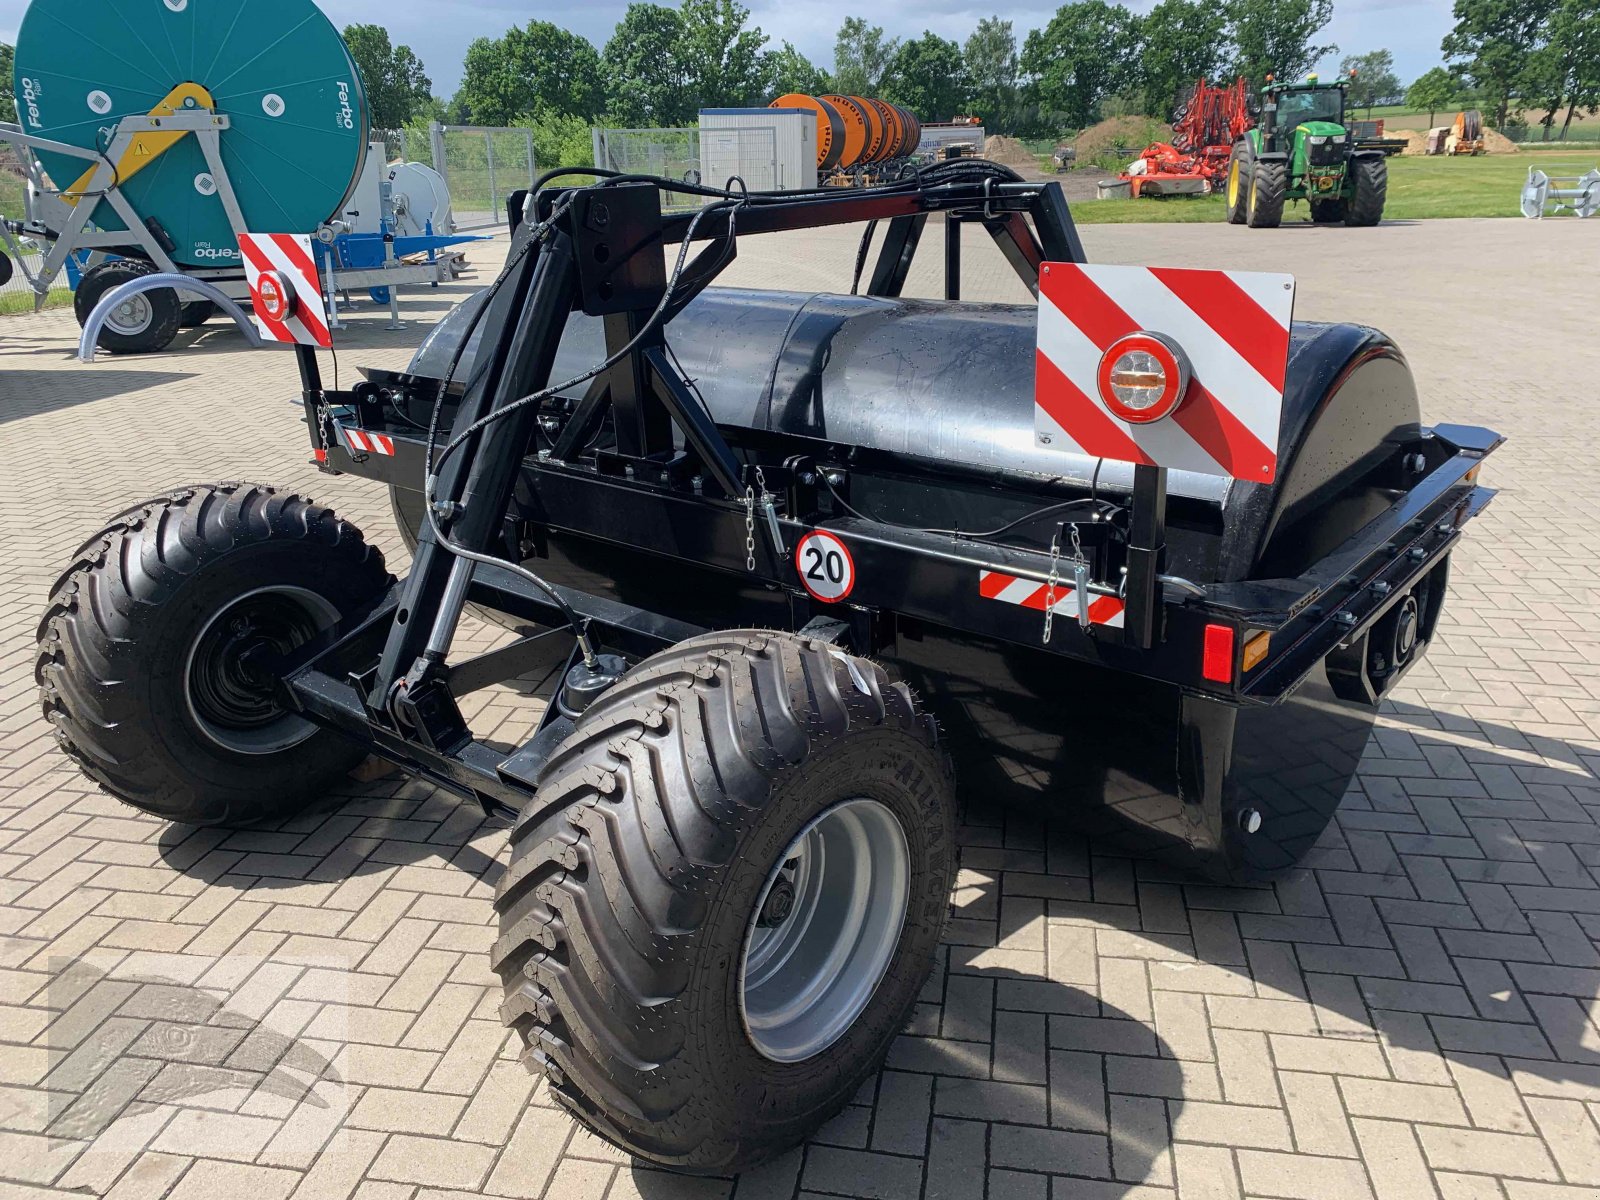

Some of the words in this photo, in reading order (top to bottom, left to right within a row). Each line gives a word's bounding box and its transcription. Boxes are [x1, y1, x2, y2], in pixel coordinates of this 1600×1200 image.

[33, 78, 43, 96] Rain
[21, 77, 42, 128] Ferbo
[336, 81, 354, 130] Ferbo
[335, 112, 344, 129] Rain
[194, 241, 211, 249] Rain
[194, 248, 242, 260] Ferbo
[805, 547, 845, 584] 20
